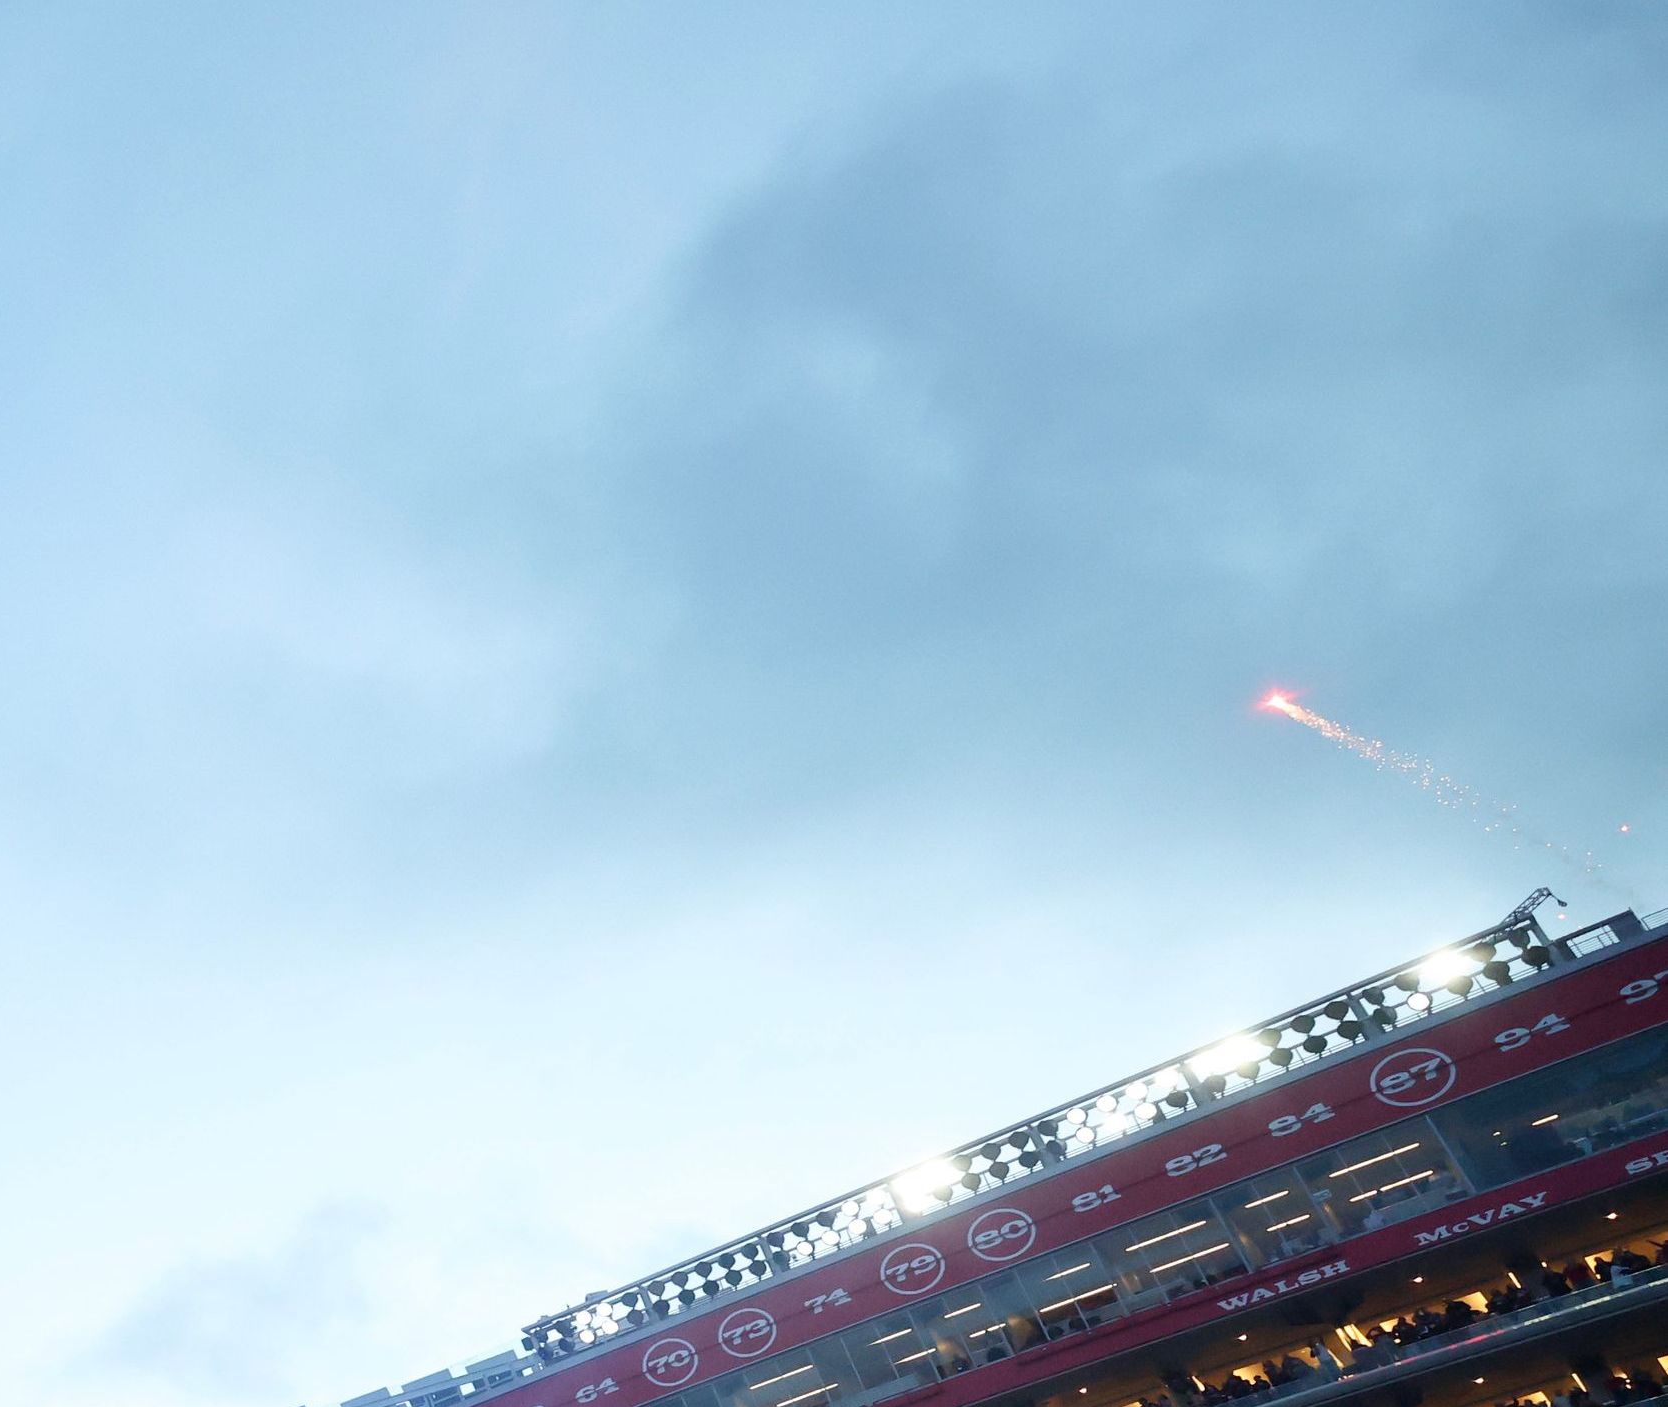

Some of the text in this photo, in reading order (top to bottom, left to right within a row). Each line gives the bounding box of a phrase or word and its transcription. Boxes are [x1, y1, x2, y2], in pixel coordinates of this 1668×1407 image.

[1494, 1013, 1571, 1052] 94
[1380, 1057, 1441, 1094] 87
[1268, 1102, 1336, 1138] 84
[1165, 1143, 1228, 1177] 82
[1071, 1183, 1122, 1213] 81
[974, 1220, 1028, 1250] 80
[886, 1254, 938, 1282] 79
[1217, 1259, 1351, 1312] WALSH
[804, 1288, 852, 1314] 74
[722, 1319, 770, 1346] 73
[647, 1349, 691, 1375] 70
[575, 1377, 619, 1404] 64
